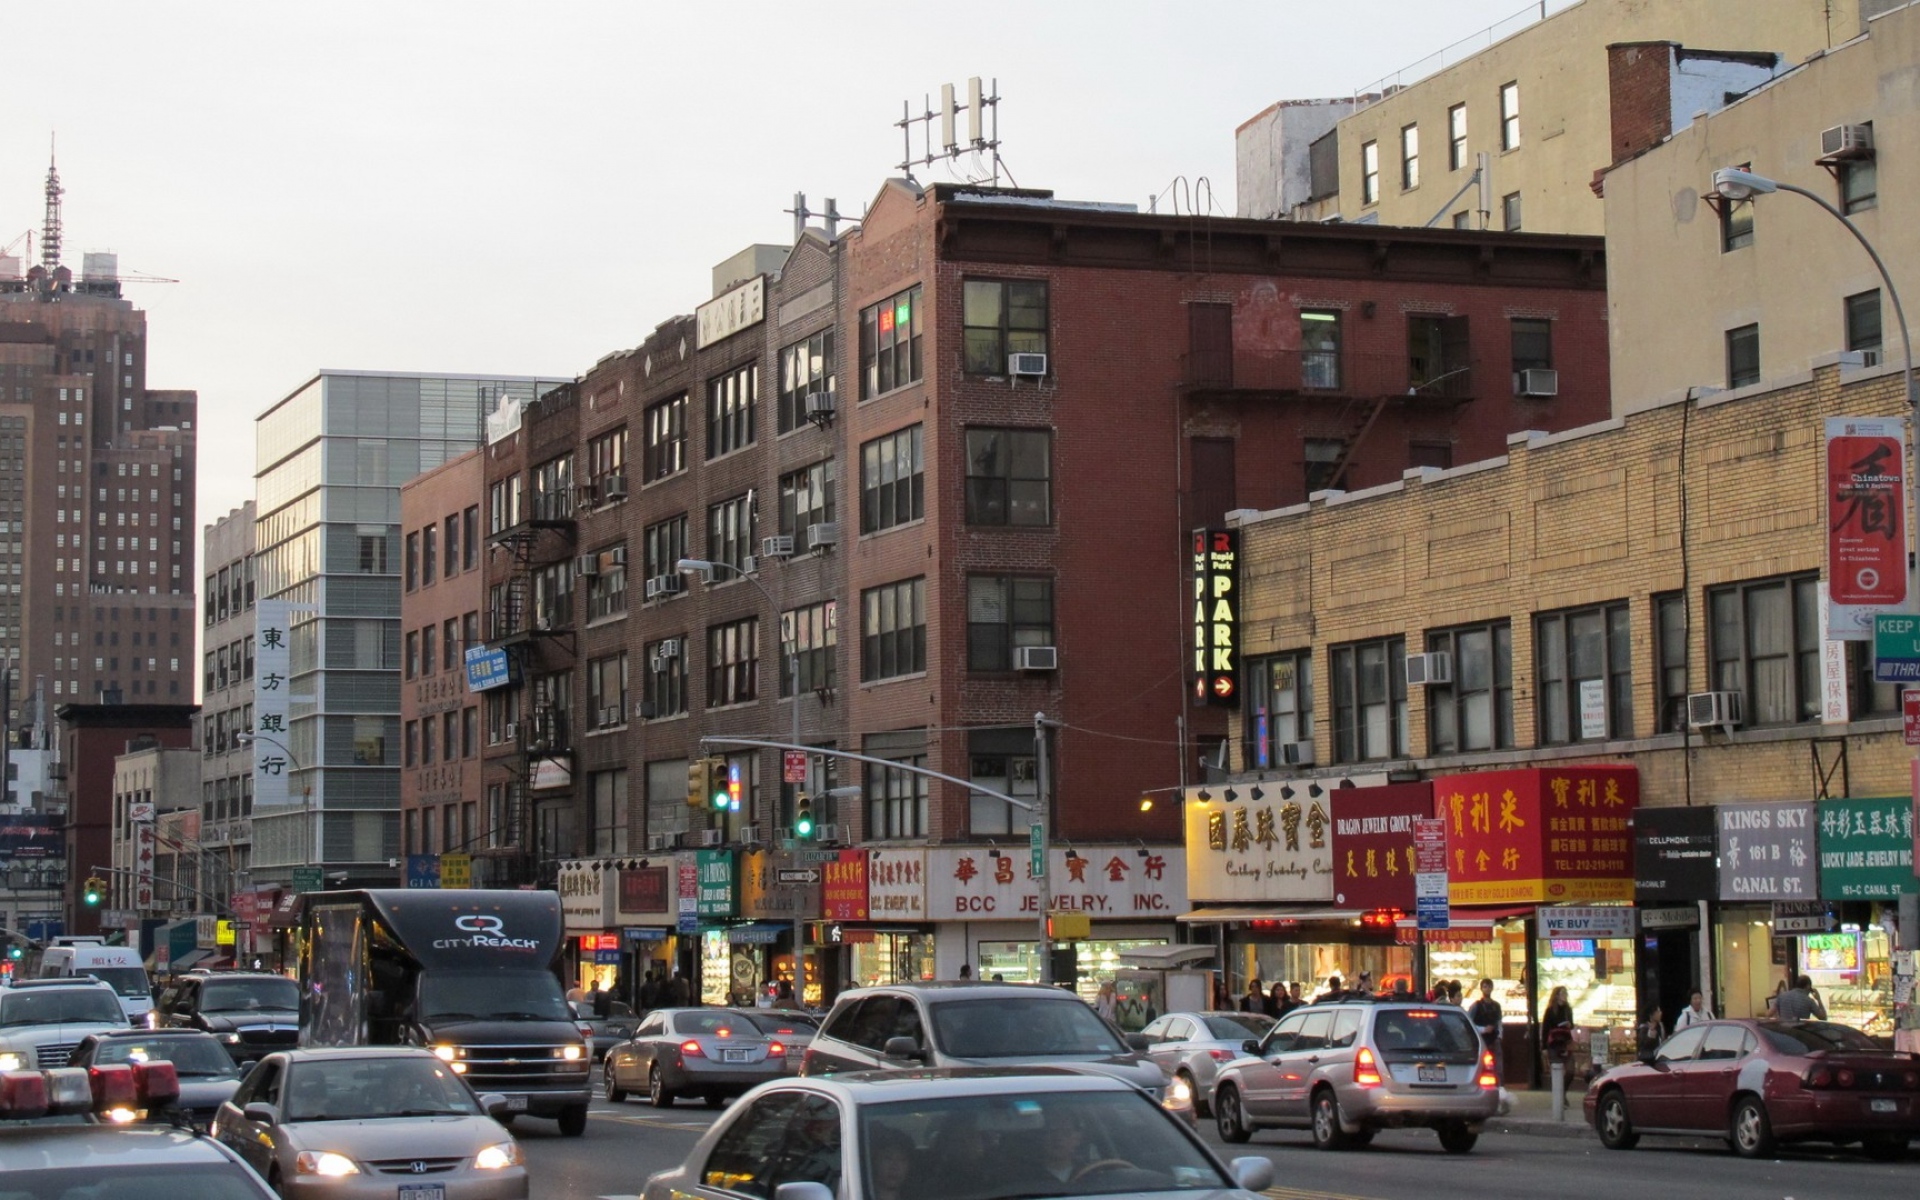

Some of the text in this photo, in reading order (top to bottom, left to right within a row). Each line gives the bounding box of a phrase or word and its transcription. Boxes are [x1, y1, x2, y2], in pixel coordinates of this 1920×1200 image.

[1850, 473, 1900, 482] Chinatown
[1211, 552, 1234, 562] Rapid
[1212, 561, 1232, 570] Park
[1195, 577, 1205, 672] PARK
[1212, 575, 1233, 671] PARK
[1879, 619, 1914, 633] KEEP
[259, 627, 287, 777] 東方銀行
[1337, 814, 1412, 836] DRAGON JEWELRY GROUP,
[1723, 808, 1808, 830] KINGS SKY
[1649, 836, 1690, 844] CELLPHONE
[1749, 845, 1767, 860] 161
[1771, 844, 1781, 860] B
[1821, 850, 1913, 868] LUCKY JADE JEWELRY INC
[953, 855, 1166, 886] 華昌寶金行
[1555, 859, 1574, 871] TEL:
[1732, 877, 1802, 893] CANAL ST.
[1863, 884, 1889, 895] CANAL
[955, 895, 996, 912] BCC
[1133, 893, 1170, 911] INC.
[1784, 901, 1810, 914] KINGS
[1547, 919, 1564, 929] WE
[1567, 919, 1590, 929] BUY
[1782, 918, 1826, 930] 161 B
